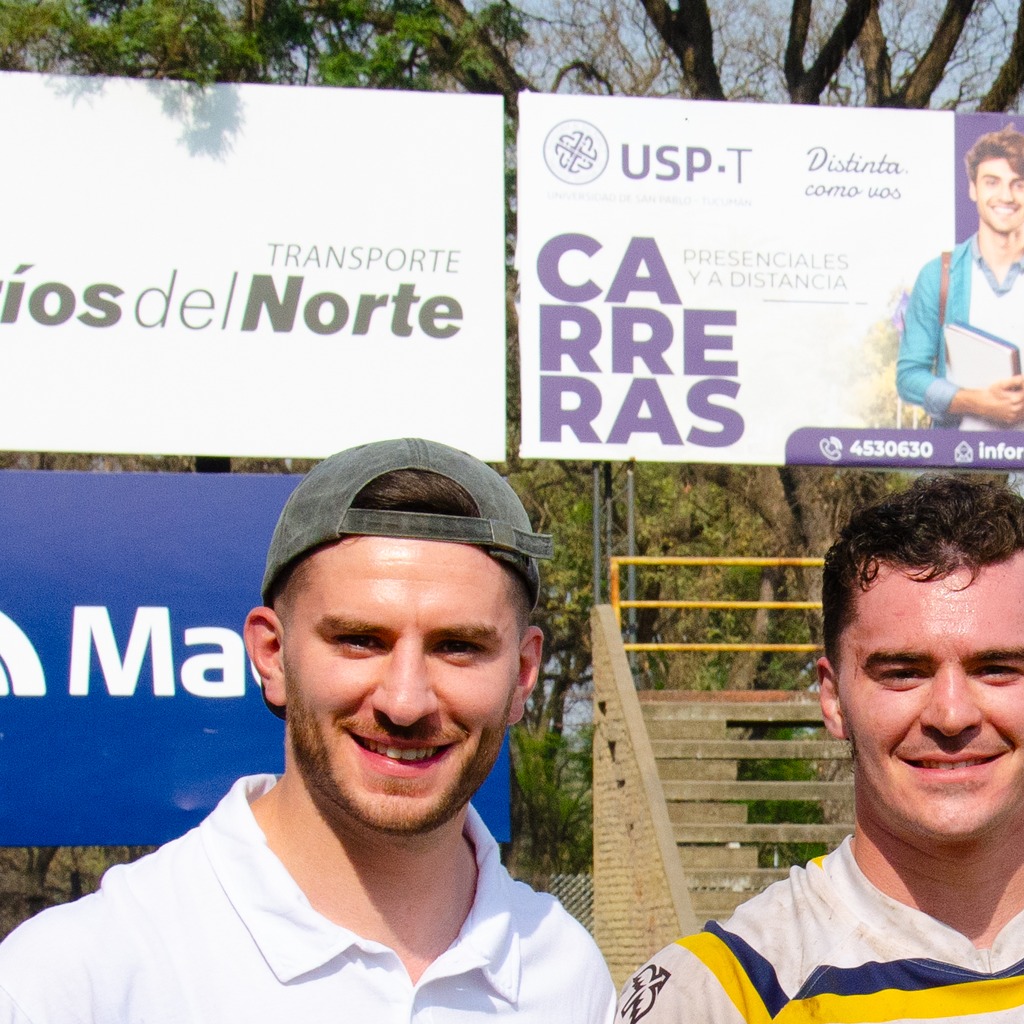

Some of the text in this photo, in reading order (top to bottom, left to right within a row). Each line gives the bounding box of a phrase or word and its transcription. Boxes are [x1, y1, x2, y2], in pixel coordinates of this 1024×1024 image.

[804, 184, 902, 200] como vos
[267, 243, 461, 274] TRANSPORTE
[683, 249, 849, 271] PRESENCIALES
[688, 271, 848, 290] Y A DISTANCIA
[849, 440, 934, 459] 4530630
[69, 605, 261, 698] Ma
